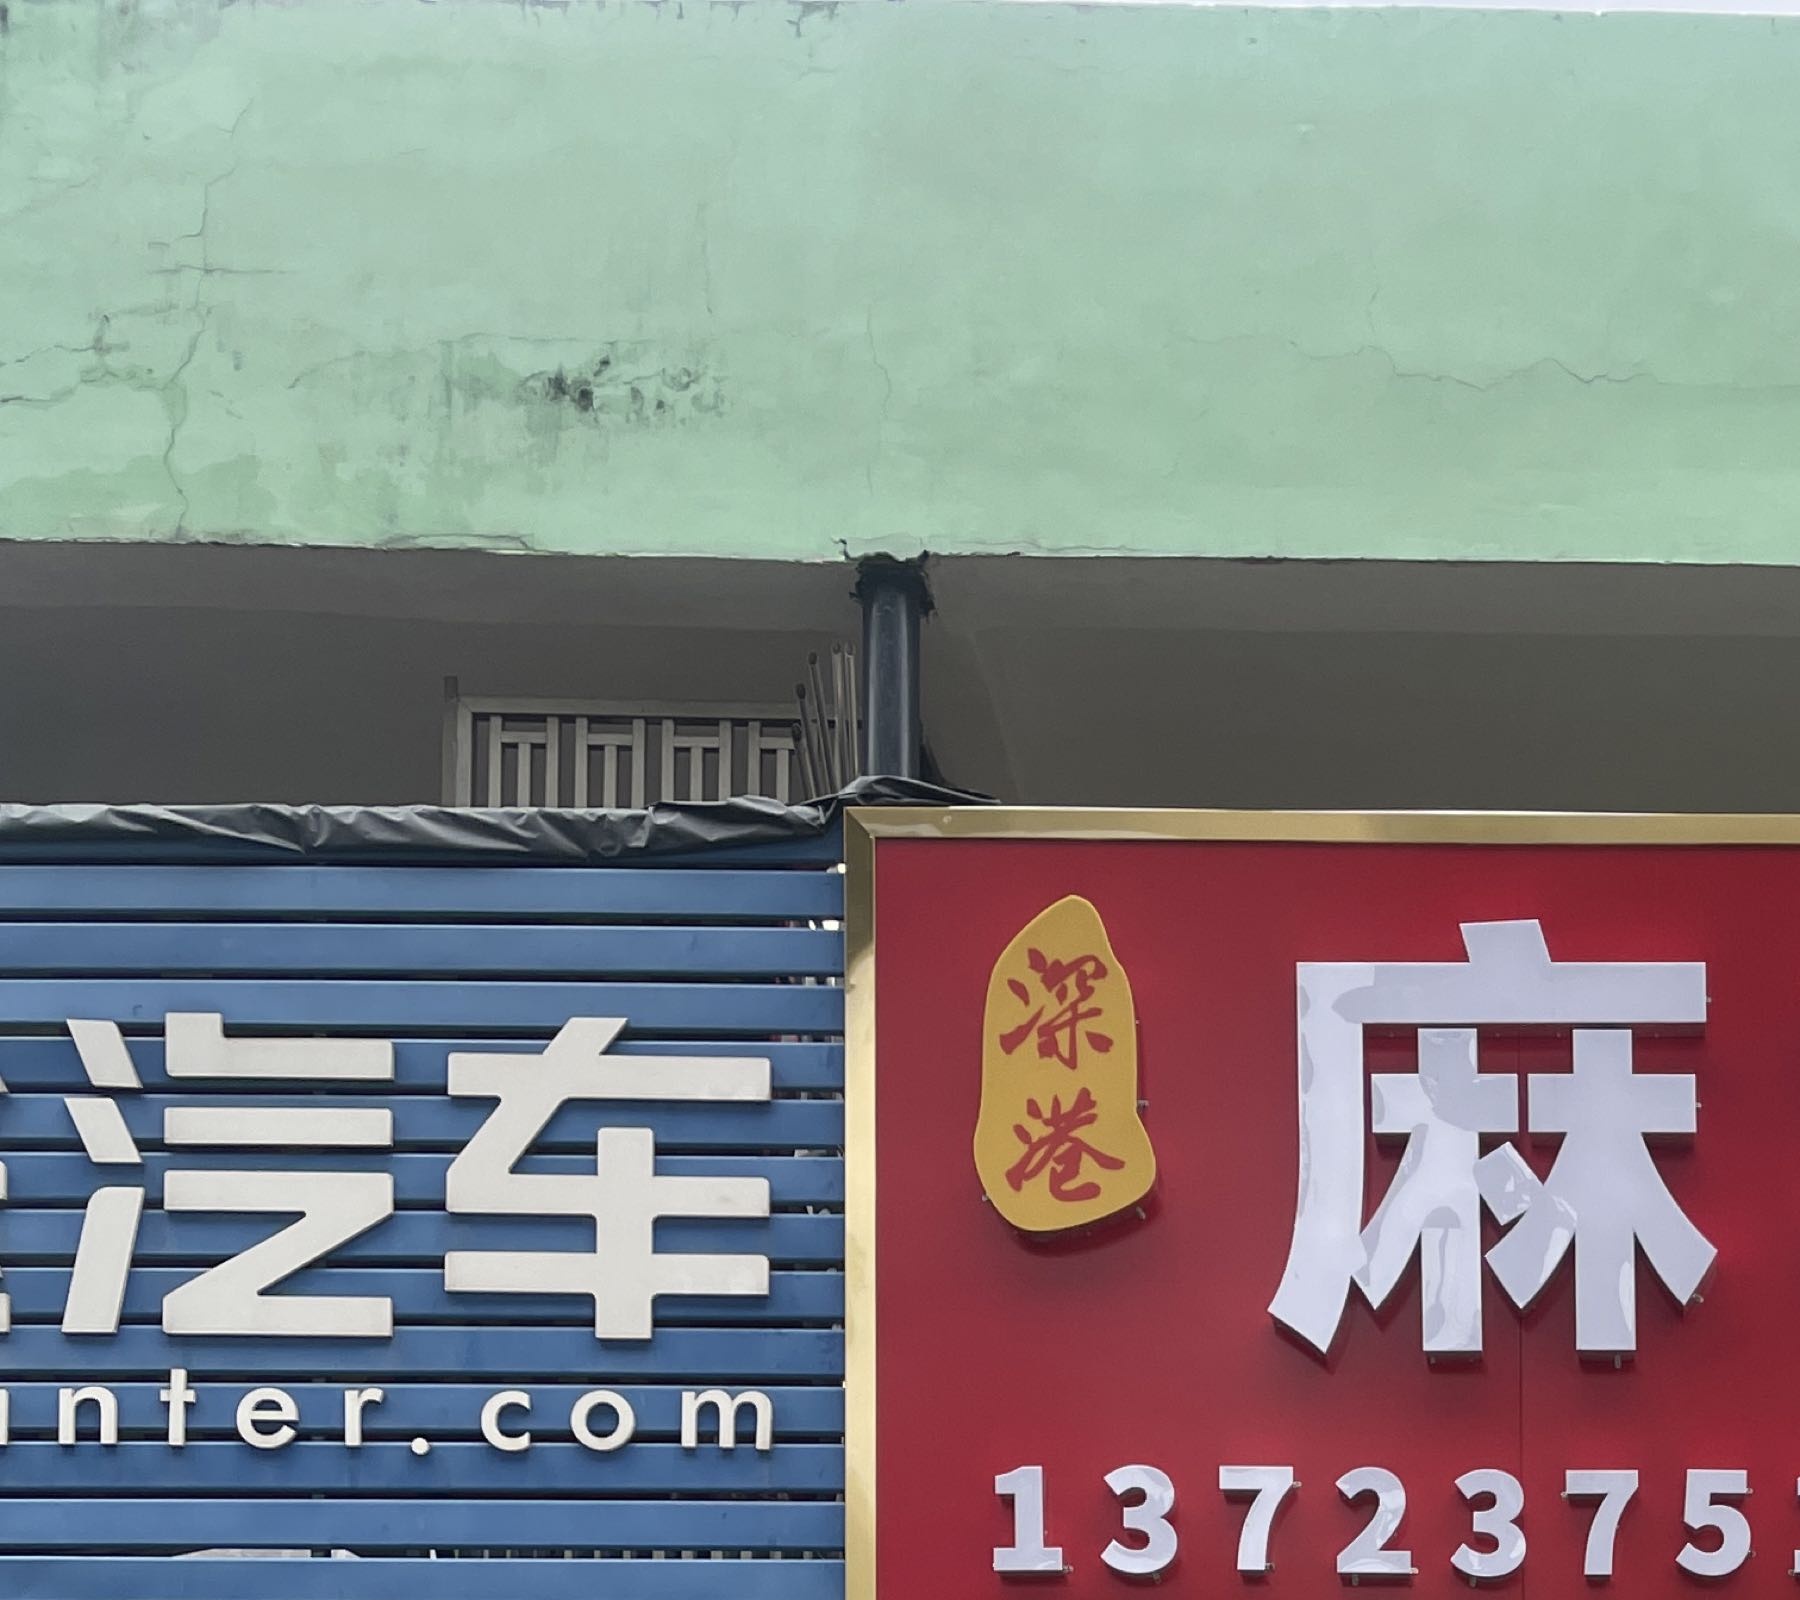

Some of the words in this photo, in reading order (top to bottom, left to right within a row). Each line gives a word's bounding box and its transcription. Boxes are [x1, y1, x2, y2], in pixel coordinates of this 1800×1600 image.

[0, 1011, 772, 1340] 汽车
[1000, 947, 1126, 1202] 深港
[0, 1367, 775, 1453] nter.com
